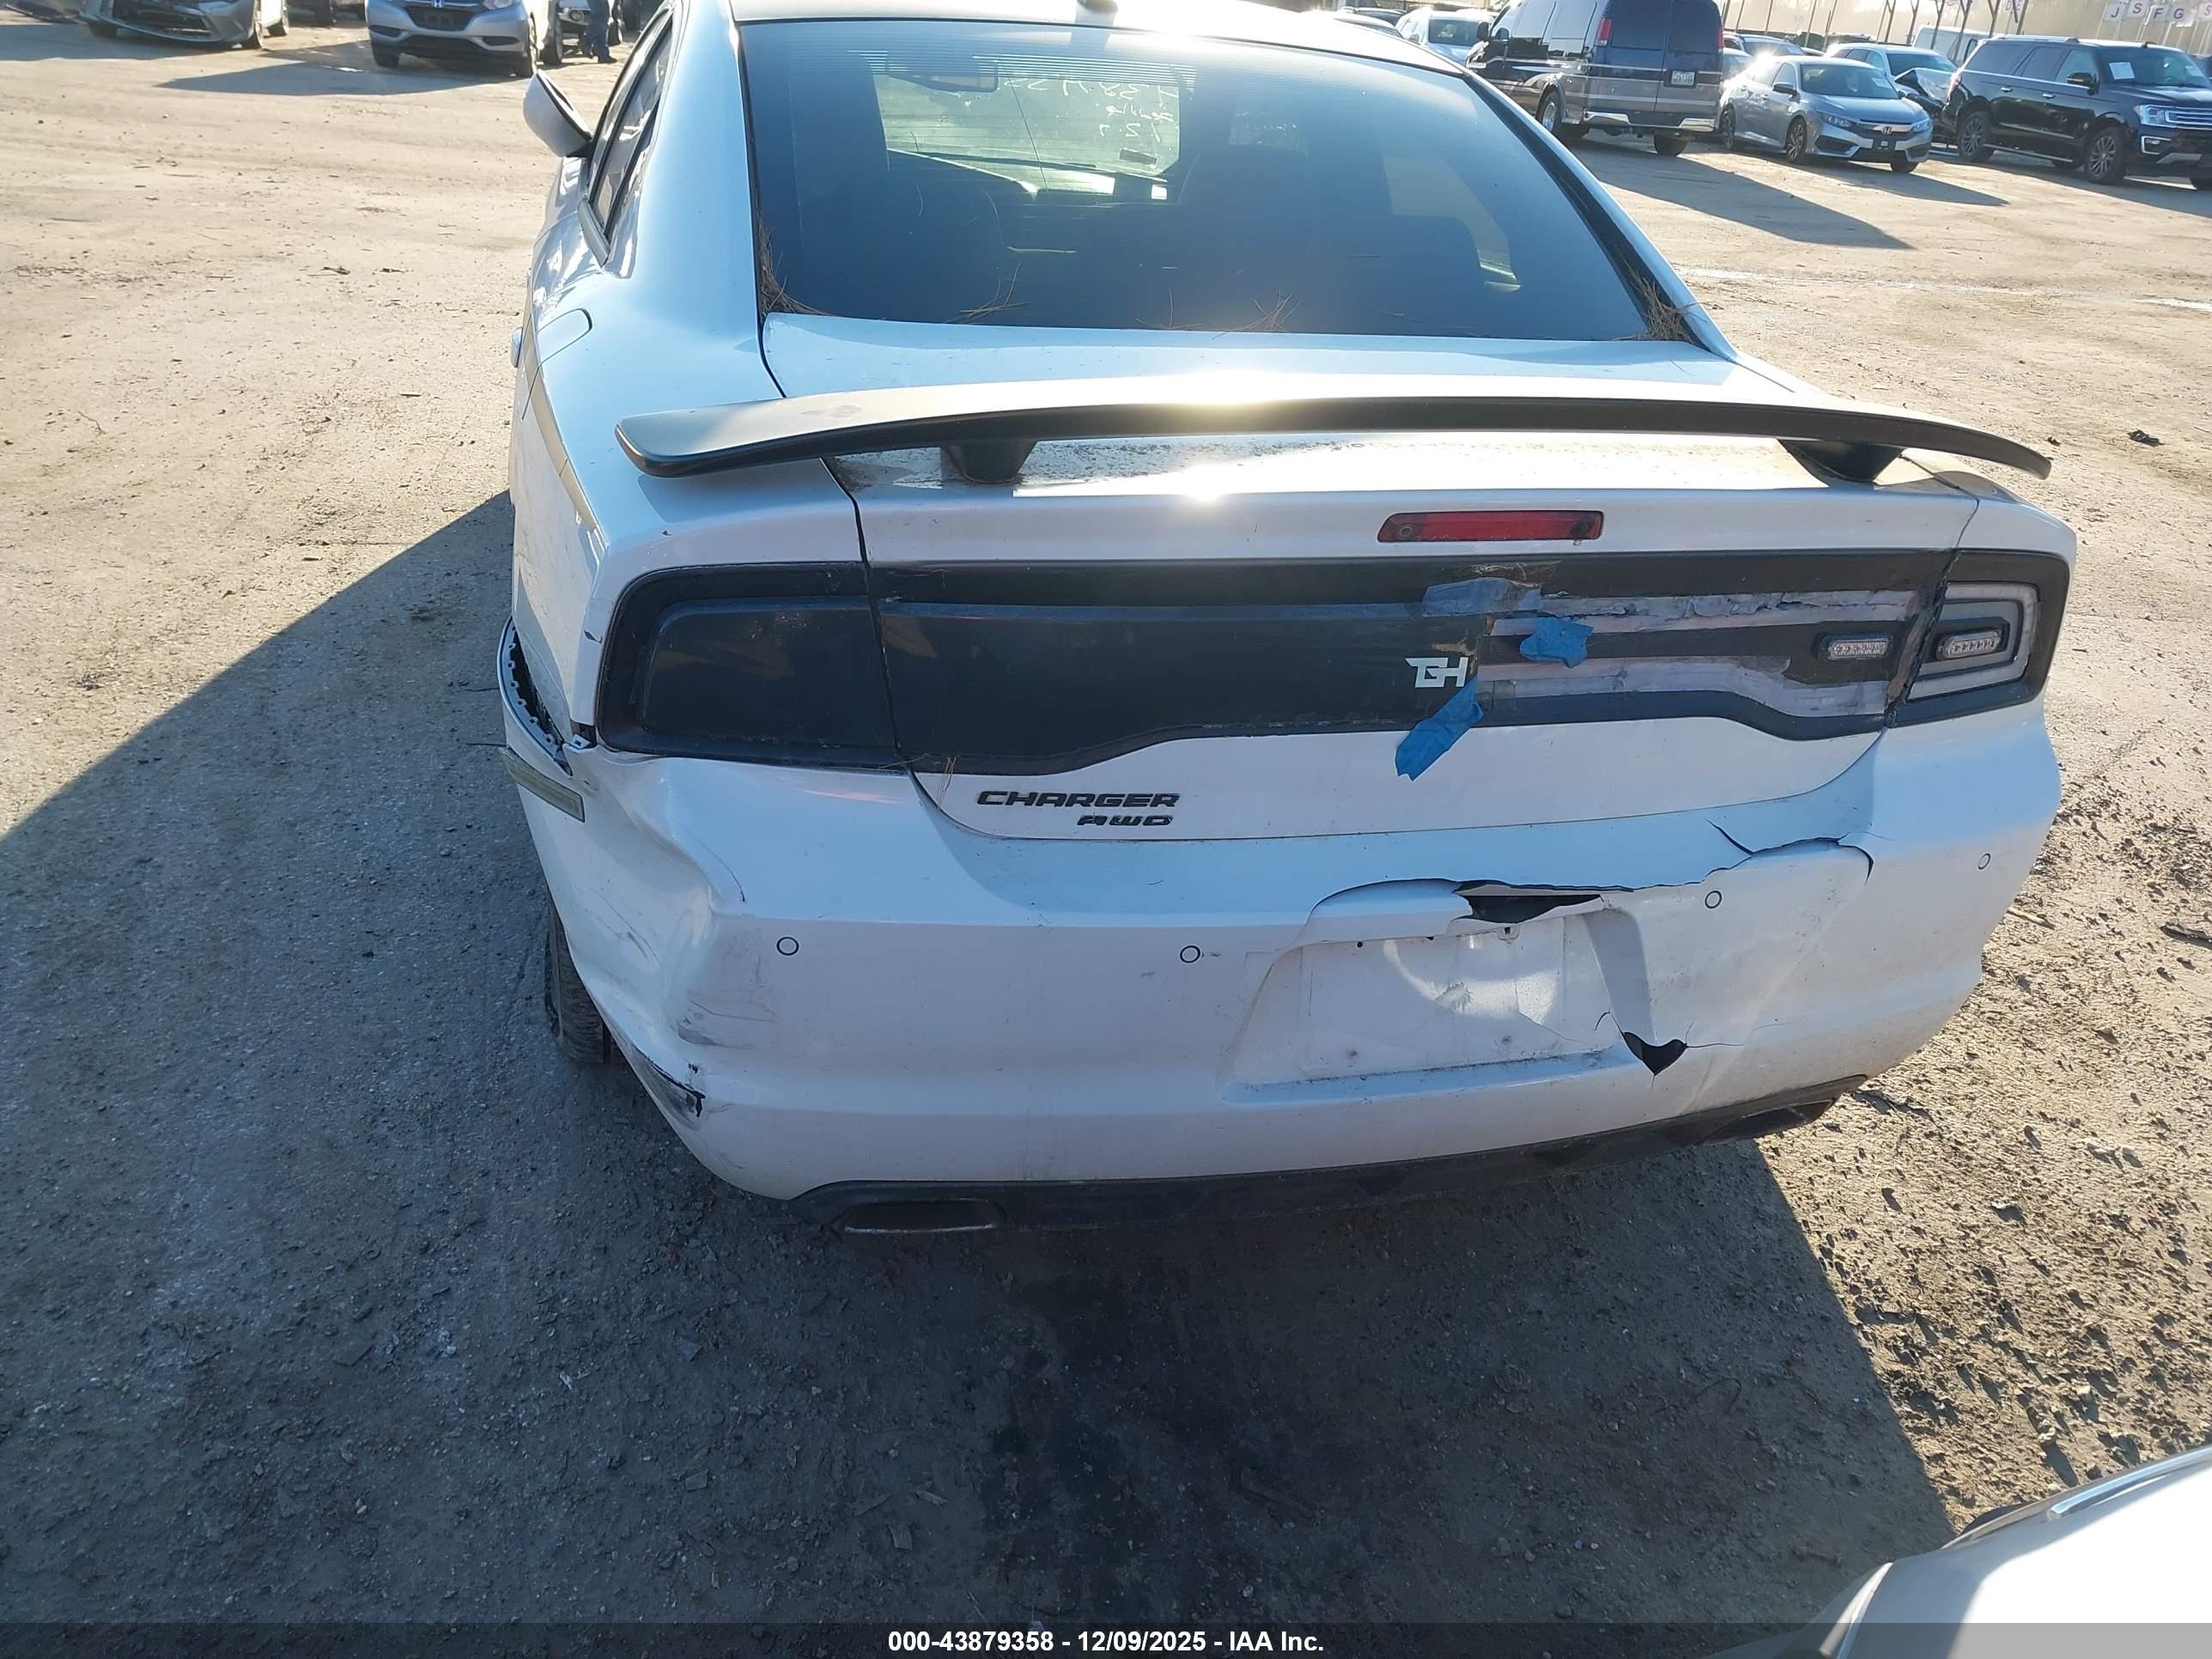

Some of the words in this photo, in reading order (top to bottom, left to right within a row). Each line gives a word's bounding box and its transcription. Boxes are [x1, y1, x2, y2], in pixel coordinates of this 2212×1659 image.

[2111, 6, 2120, 18] J
[2132, 3, 2143, 15] S
[2153, 8, 2164, 19] F
[2172, 8, 2185, 20] G
[976, 791, 1181, 808] CHARGER
[1077, 815, 1175, 827] AWD
